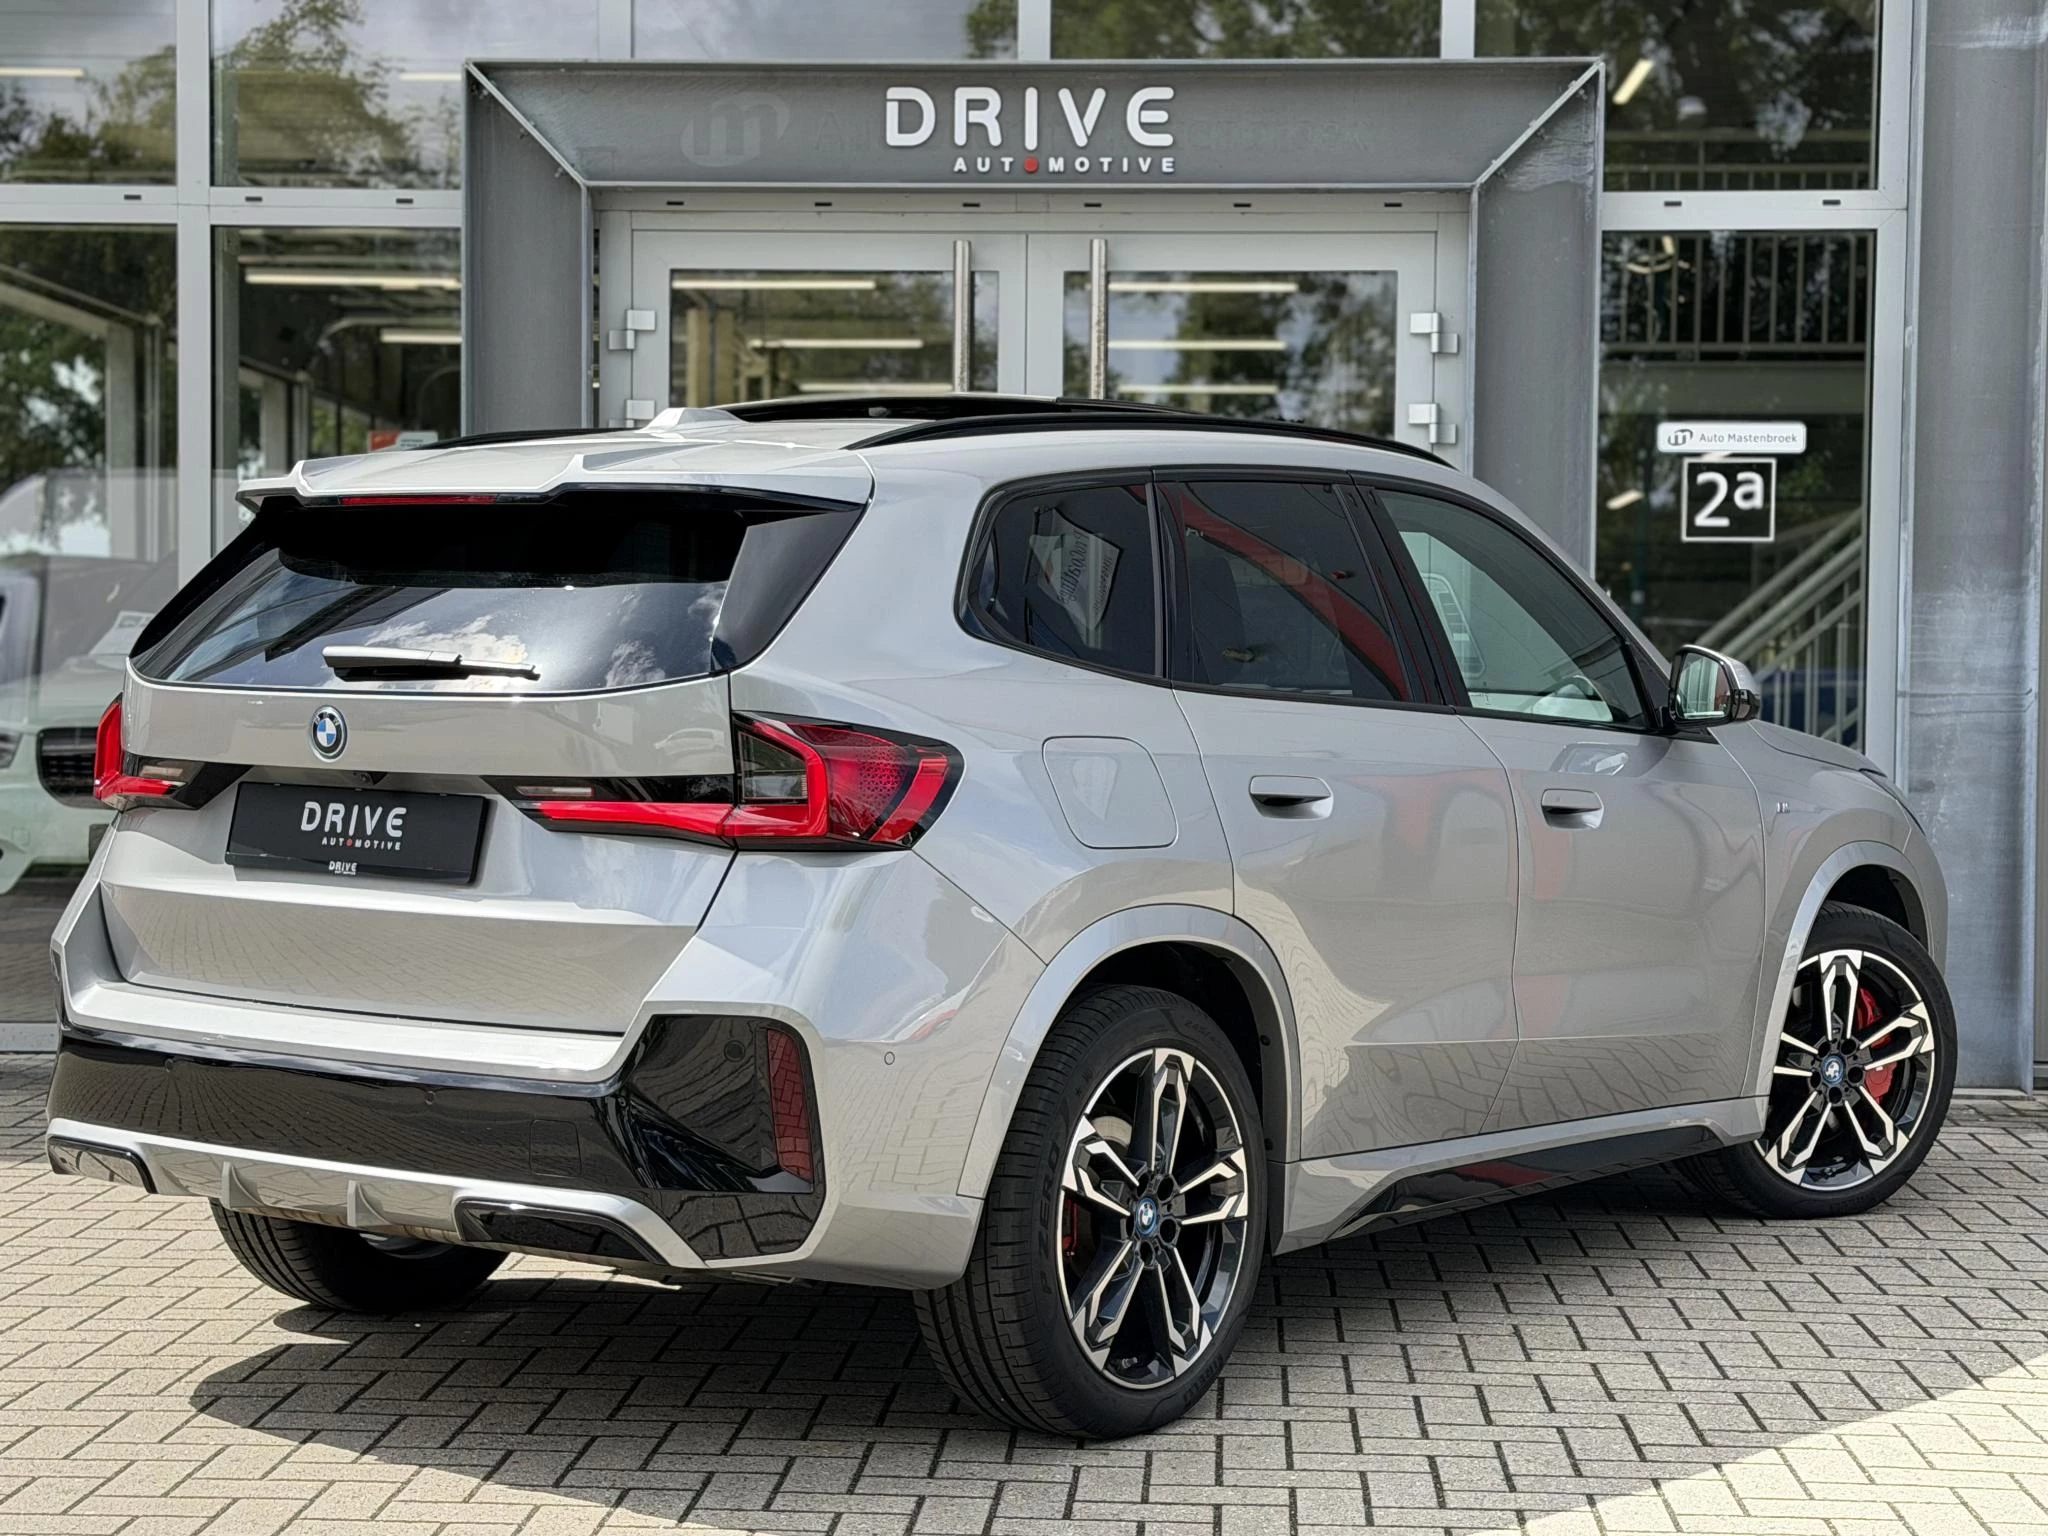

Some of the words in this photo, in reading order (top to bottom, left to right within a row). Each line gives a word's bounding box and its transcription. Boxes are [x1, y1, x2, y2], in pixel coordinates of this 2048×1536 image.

[886, 85, 1175, 152] DRIVE
[1699, 433, 1725, 443] Auto
[1727, 433, 1798, 443] Mastenbroek
[1694, 471, 1765, 528] 2a
[300, 800, 407, 838] DRIVE
[328, 860, 358, 872] DRIVE
